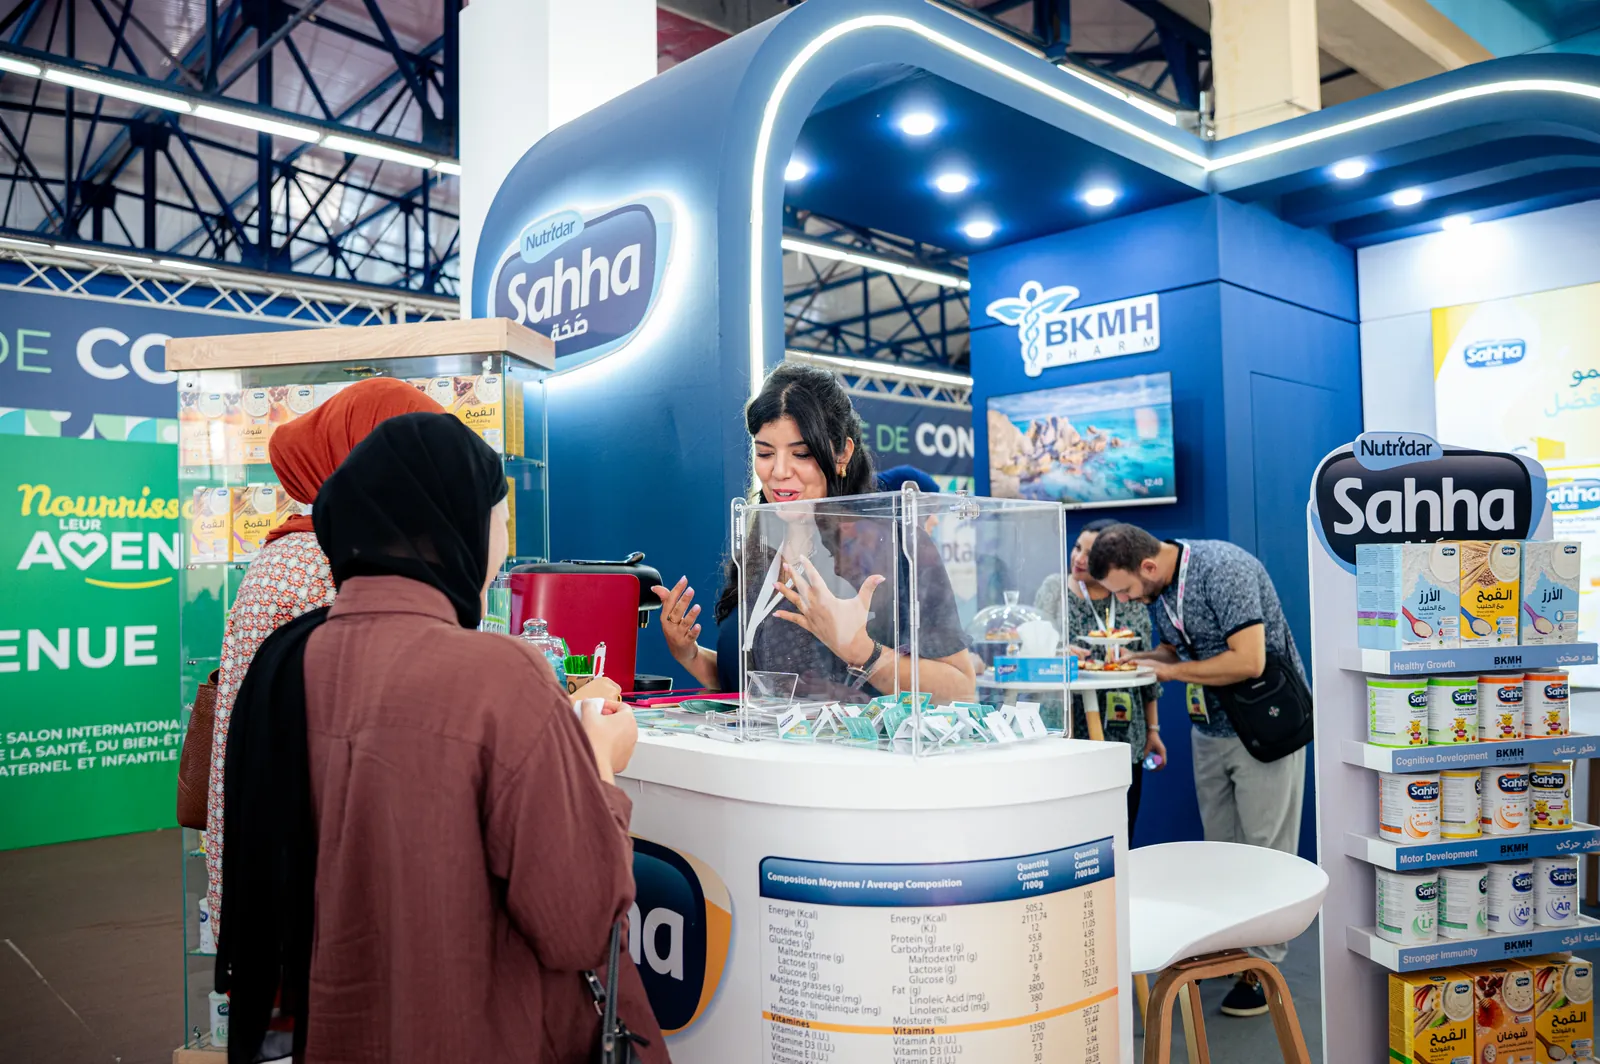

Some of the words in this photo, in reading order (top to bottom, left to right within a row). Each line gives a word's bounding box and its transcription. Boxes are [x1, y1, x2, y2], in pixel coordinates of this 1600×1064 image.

[525, 219, 576, 252] Nutridar
[508, 243, 641, 326] Sahha
[1045, 302, 1154, 348] BKMH
[876, 424, 909, 454] DE
[1360, 436, 1433, 457] Nutridar
[1333, 477, 1516, 535] Sahha
[59, 518, 101, 531] LEUR
[1418, 587, 1440, 604] الأرز
[1476, 587, 1512, 603] القمح
[1541, 586, 1563, 603] الأرز
[1393, 660, 1424, 674] Healthy
[1426, 659, 1456, 670] Growth
[1494, 655, 1522, 665] BKMH
[7, 727, 63, 745] SALON
[10, 748, 32, 760] LA
[96, 739, 118, 753] DU
[1396, 756, 1435, 767] Cognitive
[1436, 751, 1488, 763] Development
[1496, 747, 1524, 758] BKMH
[78, 757, 96, 770] ET
[102, 749, 177, 767] INFANTILE
[1531, 775, 1564, 785] Sahha
[1400, 853, 1424, 864] Motor
[1425, 849, 1478, 862] Development
[1500, 843, 1528, 853] BKMH
[1017, 858, 1050, 871] Quantité
[767, 872, 818, 887] Composition
[819, 877, 860, 890] Moyenne
[866, 880, 904, 891] Average
[905, 878, 963, 890] Composition
[1017, 869, 1050, 881] Contents
[1022, 880, 1044, 891] /100g
[768, 904, 796, 918] Energie
[1556, 901, 1571, 911] AR
[890, 914, 921, 925] Energy
[1422, 918, 1433, 929] LF
[890, 934, 923, 944] Protein
[890, 944, 952, 955] Carbohydrate
[1403, 953, 1439, 966] Stronger
[1440, 947, 1478, 960] Immunity
[1504, 939, 1532, 949] BKMH
[908, 953, 965, 964] Maltodextrin
[908, 965, 943, 974] Lactose
[908, 975, 944, 984] Glucose
[892, 985, 905, 995] Fat
[770, 1013, 810, 1029] Vitamines
[892, 1016, 932, 1025] Moisture
[1551, 1011, 1587, 1027] القمح
[893, 1026, 936, 1035] Vitamins
[1430, 1028, 1467, 1046] القمح
[1496, 1026, 1528, 1043] شوفان
[893, 1036, 928, 1045] Vitamin
[893, 1046, 928, 1056] Vitamin
